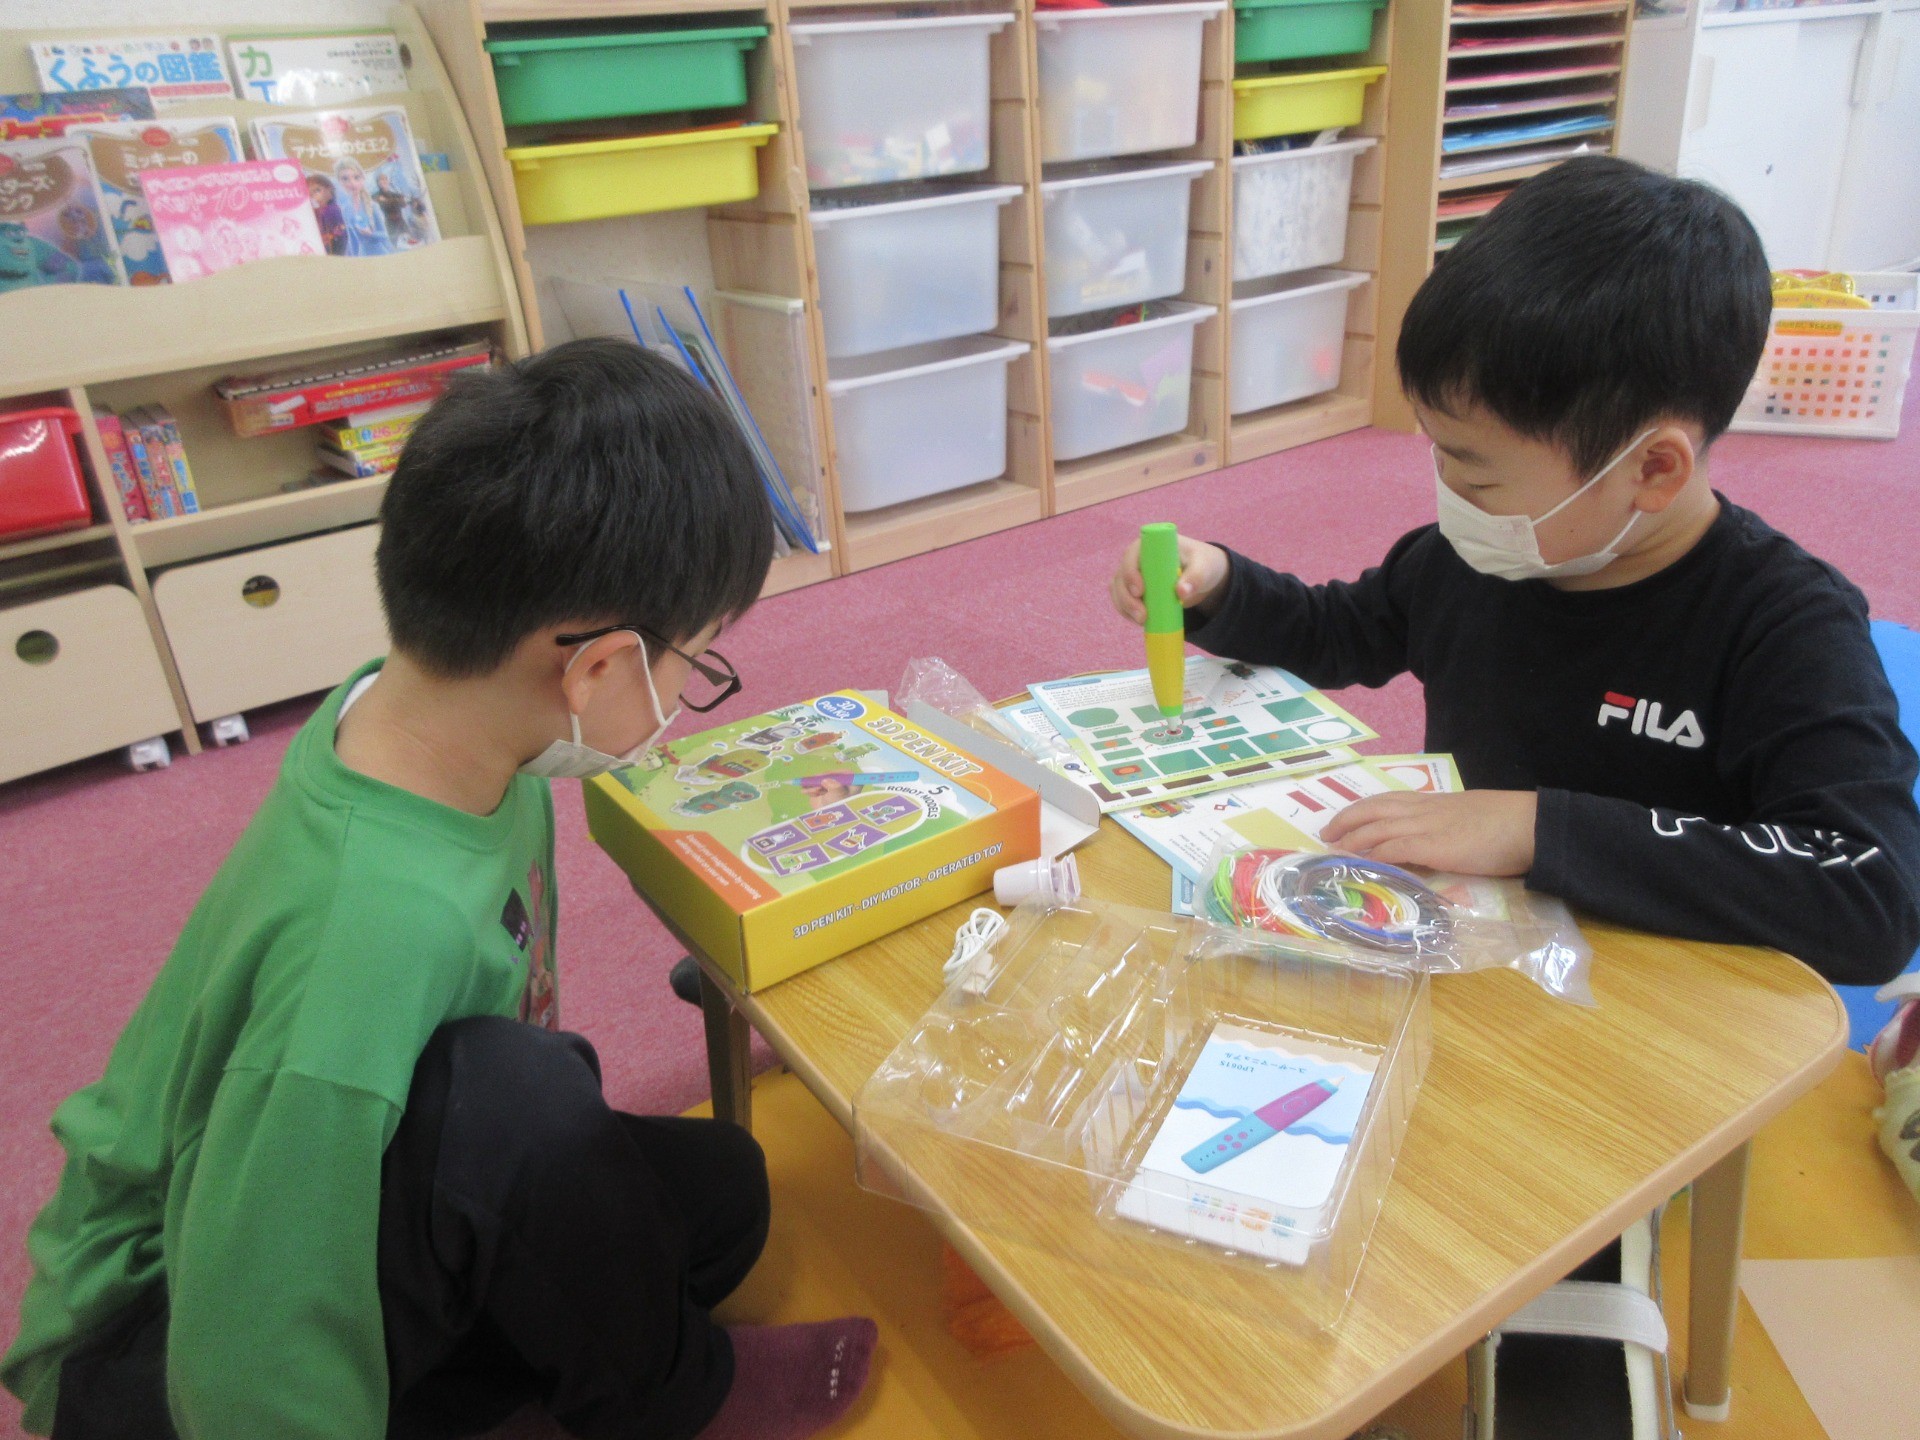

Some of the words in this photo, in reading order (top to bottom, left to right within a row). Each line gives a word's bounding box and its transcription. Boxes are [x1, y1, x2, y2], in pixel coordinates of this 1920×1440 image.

[48, 51, 225, 92] くふうの図鑑
[291, 137, 390, 159] アナとの女王2
[832, 709, 850, 719] Kit
[836, 700, 857, 711] 3D
[1597, 690, 1704, 748] FILA
[866, 716, 905, 735] 3D
[890, 730, 947, 758] PEN
[929, 752, 983, 777] KIT
[887, 785, 923, 796] ROBOT
[921, 794, 939, 818] MODELS
[928, 785, 950, 795] 5
[793, 923, 809, 939] 3D
[810, 913, 835, 932] PEN
[835, 903, 854, 921] KIT
[861, 893, 880, 911] DIY
[880, 876, 922, 903] MOTOR
[927, 852, 982, 883] OPERATED
[982, 841, 1004, 860] TOY
[1224, 1052, 1307, 1074] ユーザーマニュアル
